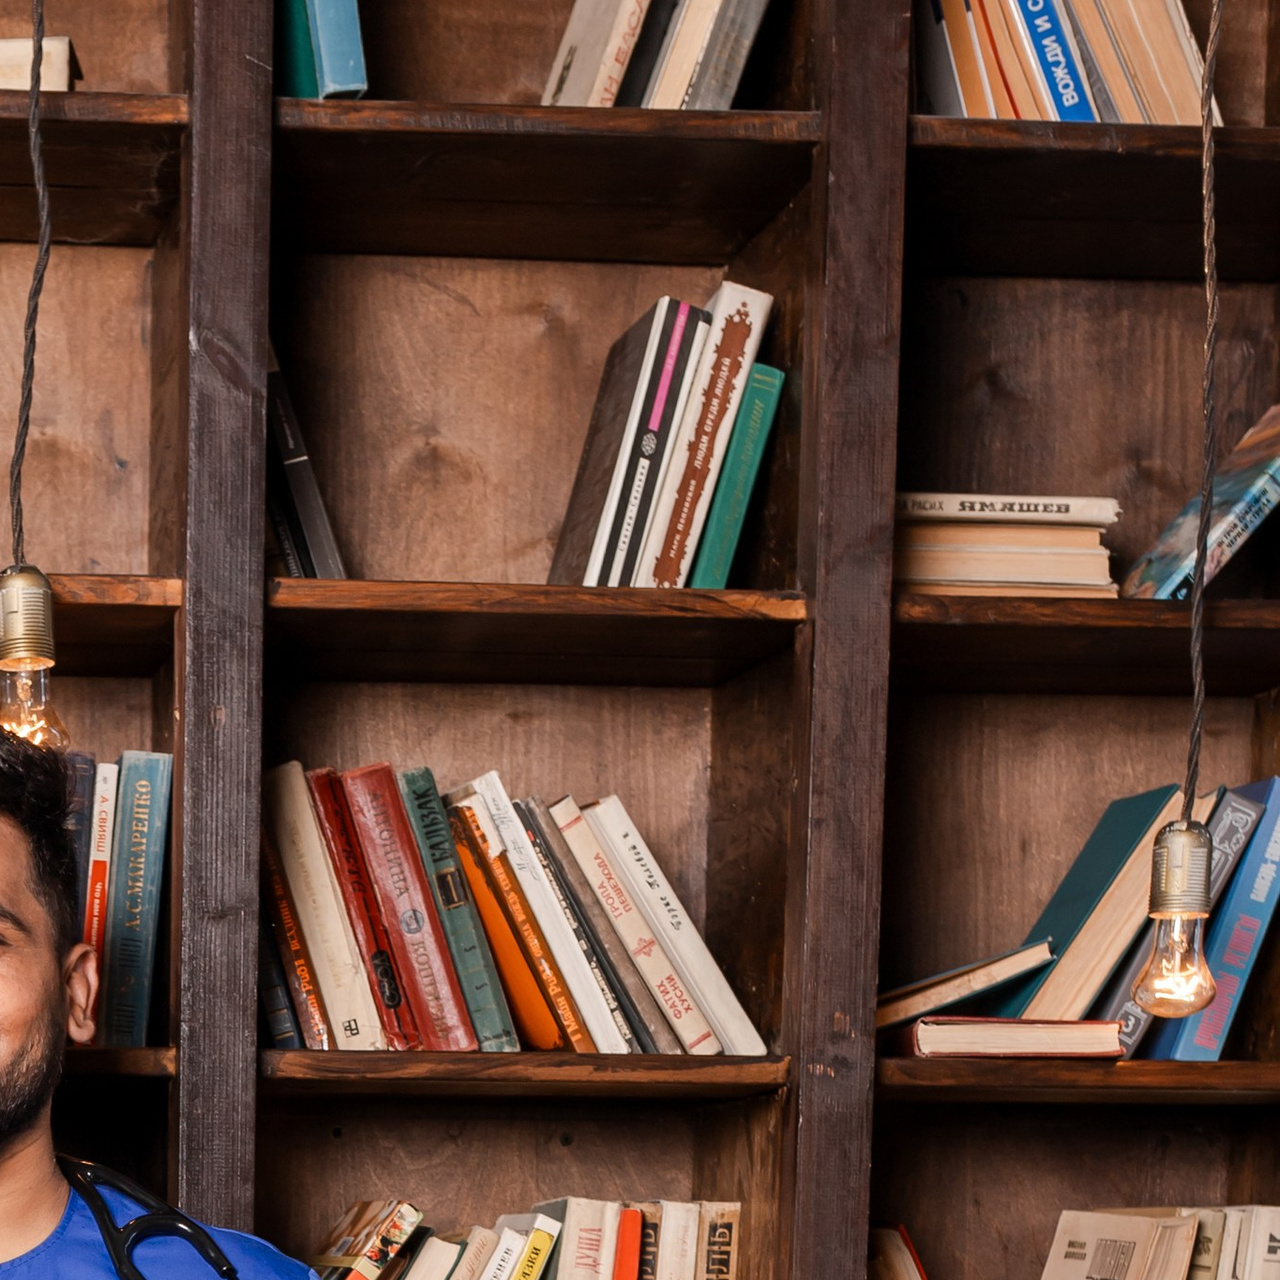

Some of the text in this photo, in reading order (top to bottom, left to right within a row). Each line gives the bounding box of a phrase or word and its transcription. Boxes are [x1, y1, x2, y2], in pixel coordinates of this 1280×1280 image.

[1033, 14, 1080, 108] ВОЖДИ И
[691, 433, 709, 469] ЛЮДИ
[702, 397, 719, 432] СРЕДИ
[712, 356, 731, 395] ЛЮДЕЙ
[958, 501, 1070, 512] ЯМАШЕВ
[95, 809, 108, 852] СВИЯШ
[411, 784, 453, 864] БАЛЬЗАК
[93, 881, 102, 897] Что
[592, 850, 633, 913] ПЕШЕХОДА
[596, 880, 623, 919] ТРОПА
[91, 898, 100, 915] вам
[506, 891, 527, 921] ВОЖДЬ
[295, 963, 313, 991] Рид
[664, 972, 693, 1014] ХУСНИ
[553, 995, 579, 1032] Майн
[655, 979, 684, 1021] ФАТИХ
[574, 1224, 602, 1273] ДУША
